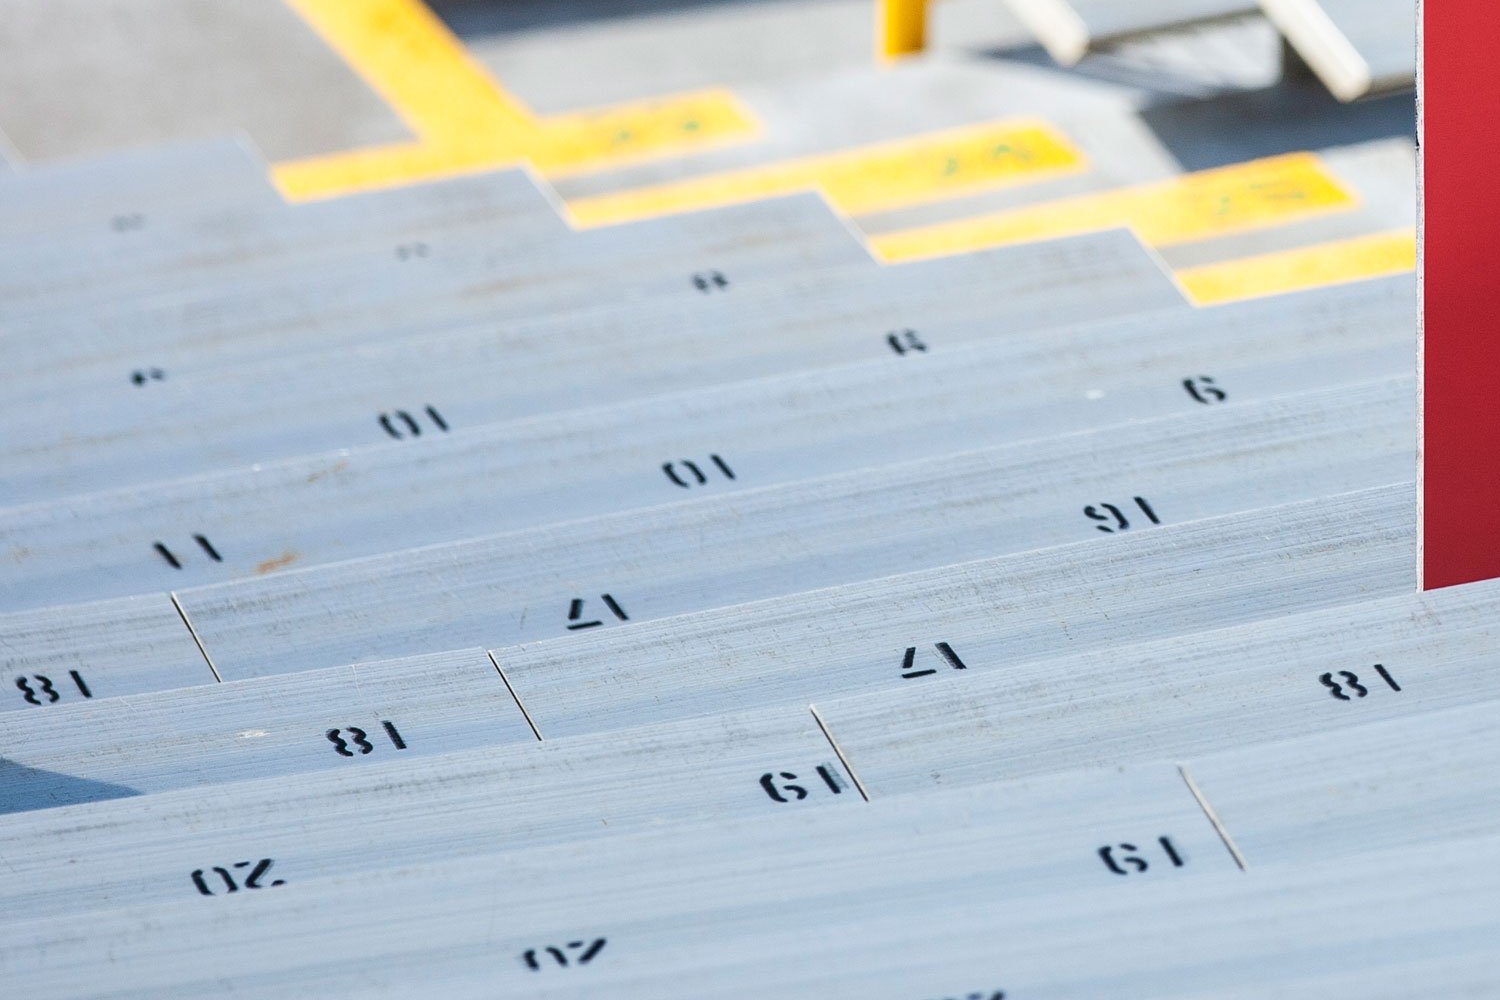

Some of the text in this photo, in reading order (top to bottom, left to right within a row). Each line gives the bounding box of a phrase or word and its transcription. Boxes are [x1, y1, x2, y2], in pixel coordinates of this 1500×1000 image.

[1083, 495, 1161, 533] 16
[14, 669, 94, 706] 18
[1318, 663, 1402, 701] 18
[326, 719, 408, 758] 18
[758, 761, 844, 803] 19
[1097, 835, 1185, 876] 19
